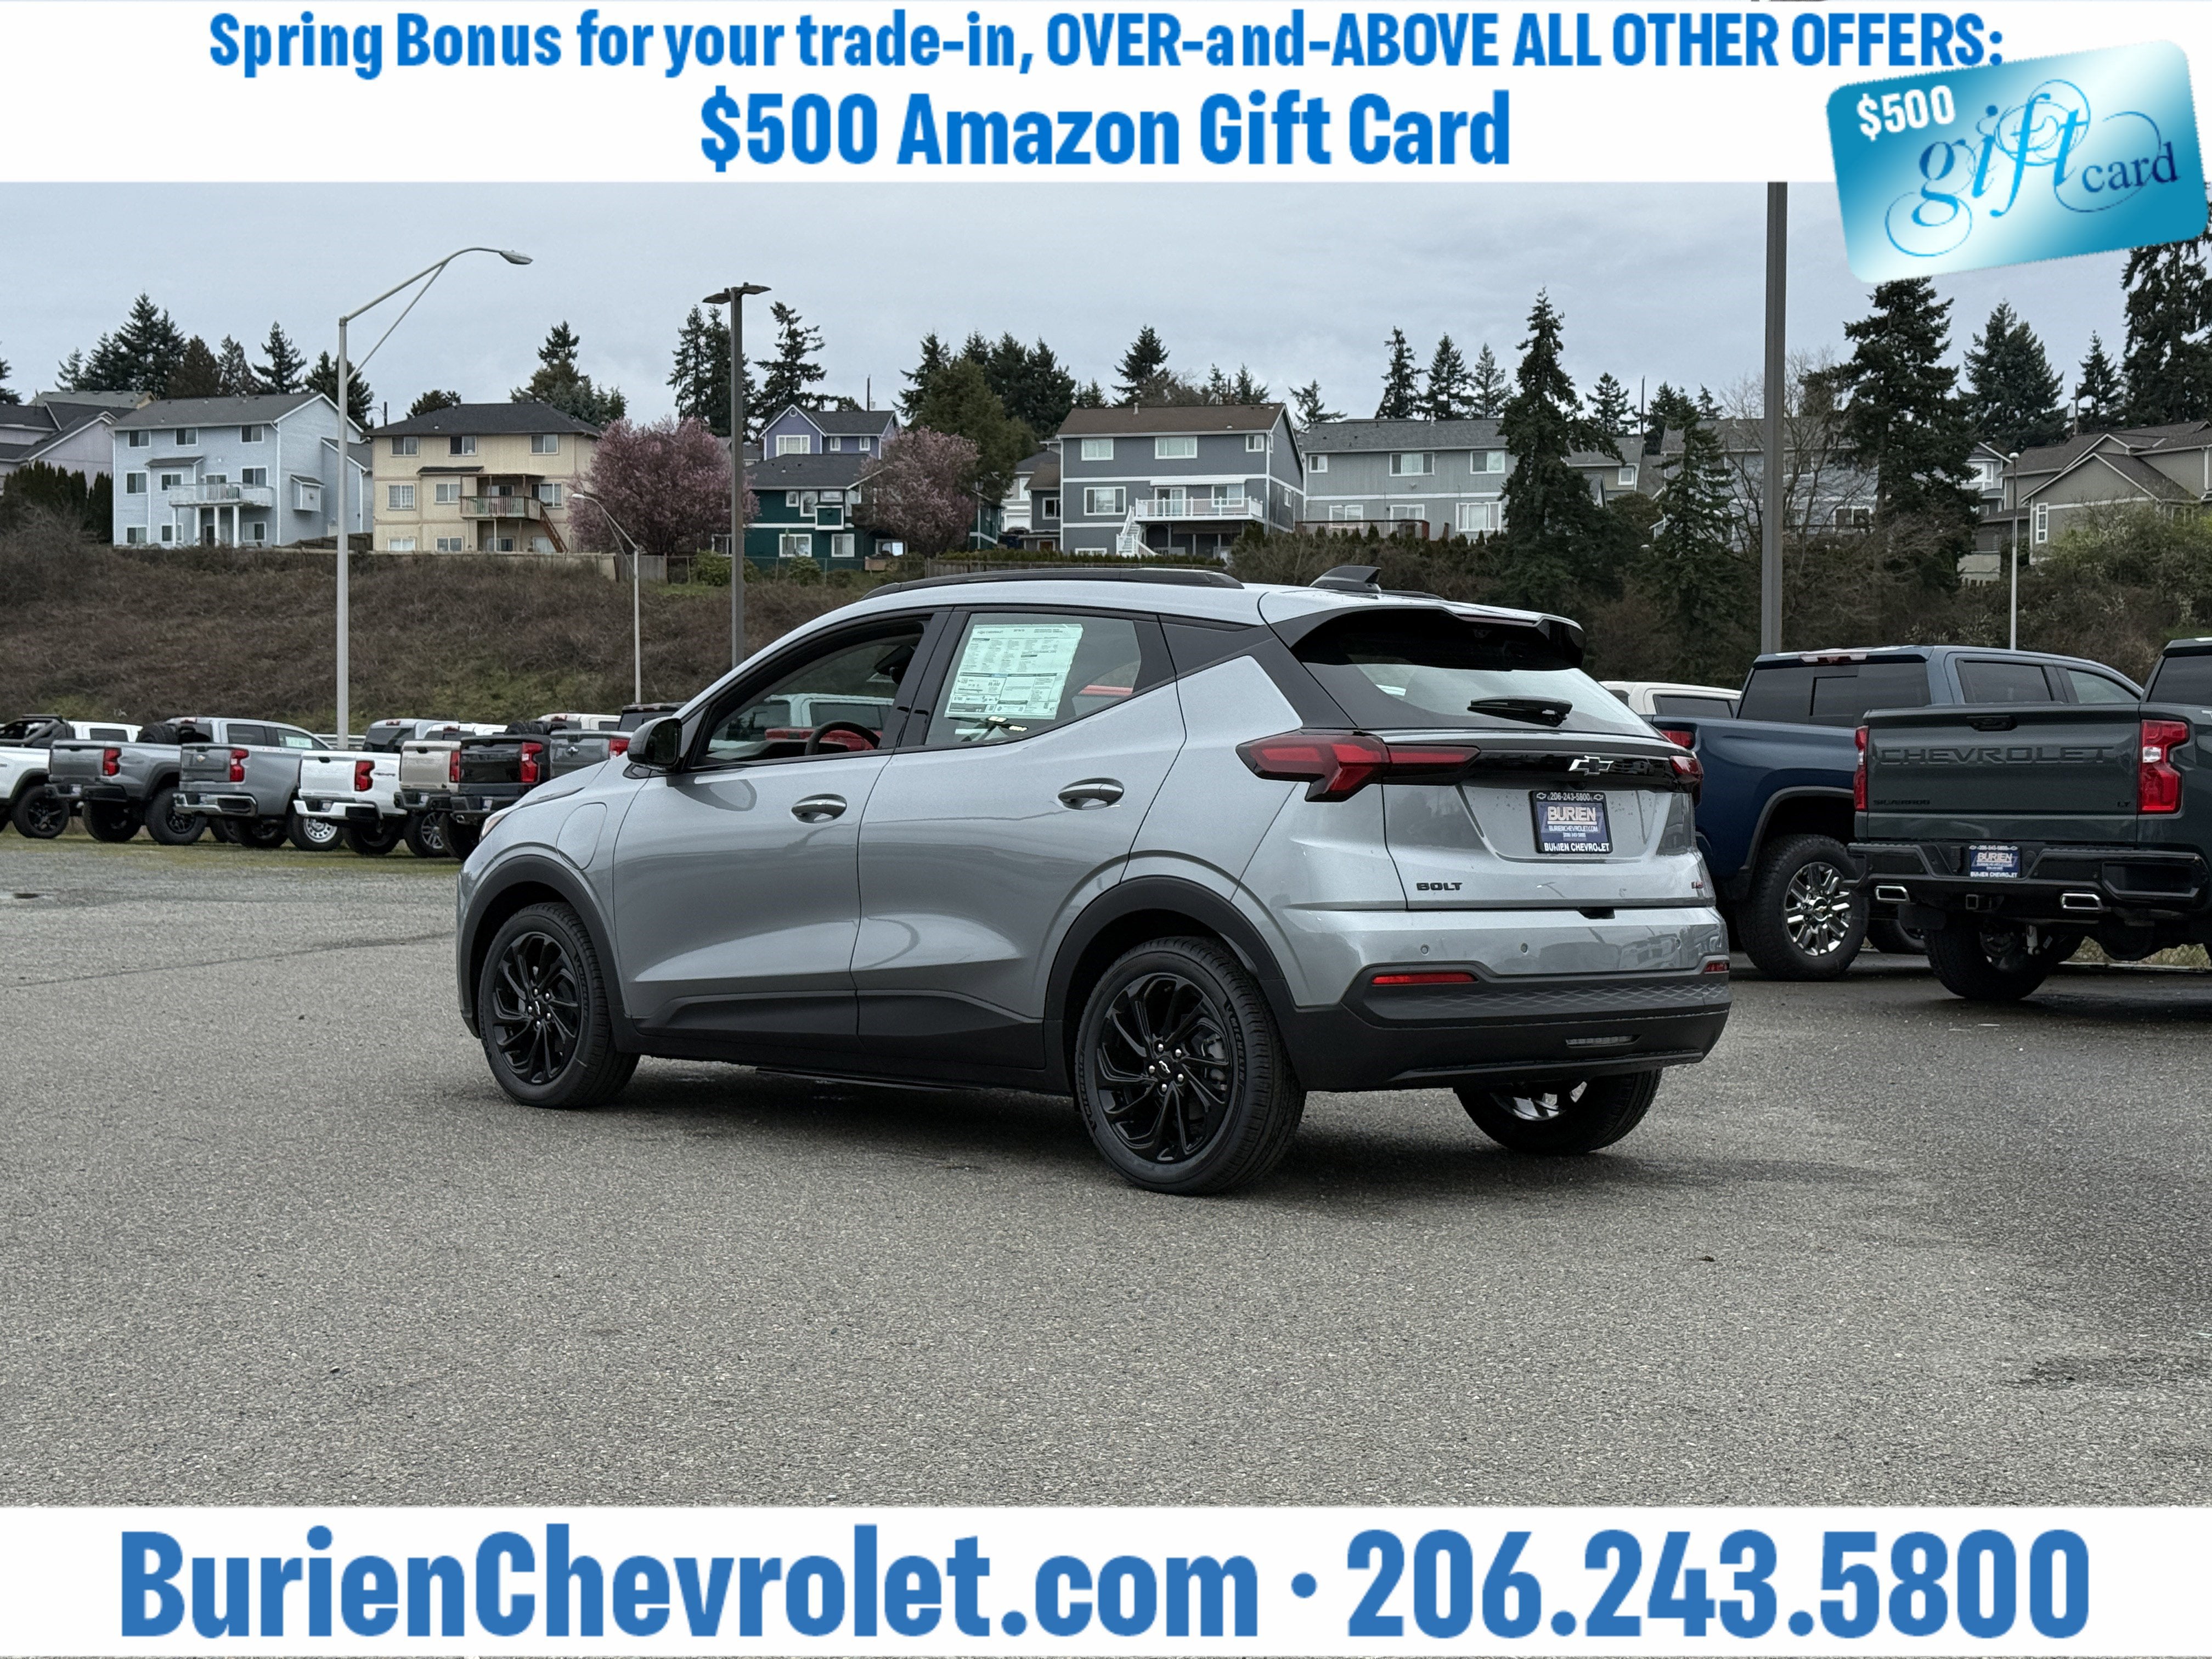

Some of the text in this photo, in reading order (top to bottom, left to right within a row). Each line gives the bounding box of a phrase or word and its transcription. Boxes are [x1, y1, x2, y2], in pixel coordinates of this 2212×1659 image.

[1880, 746, 2115, 765] CHEVROLET
[1550, 792, 1590, 801] 206-243-5800
[1548, 806, 1596, 821] BURIEN
[1544, 842, 1610, 852] BURIEN CHEVROLET
[1977, 852, 2013, 861] BURIEN
[1417, 882, 1463, 890] BOLT
